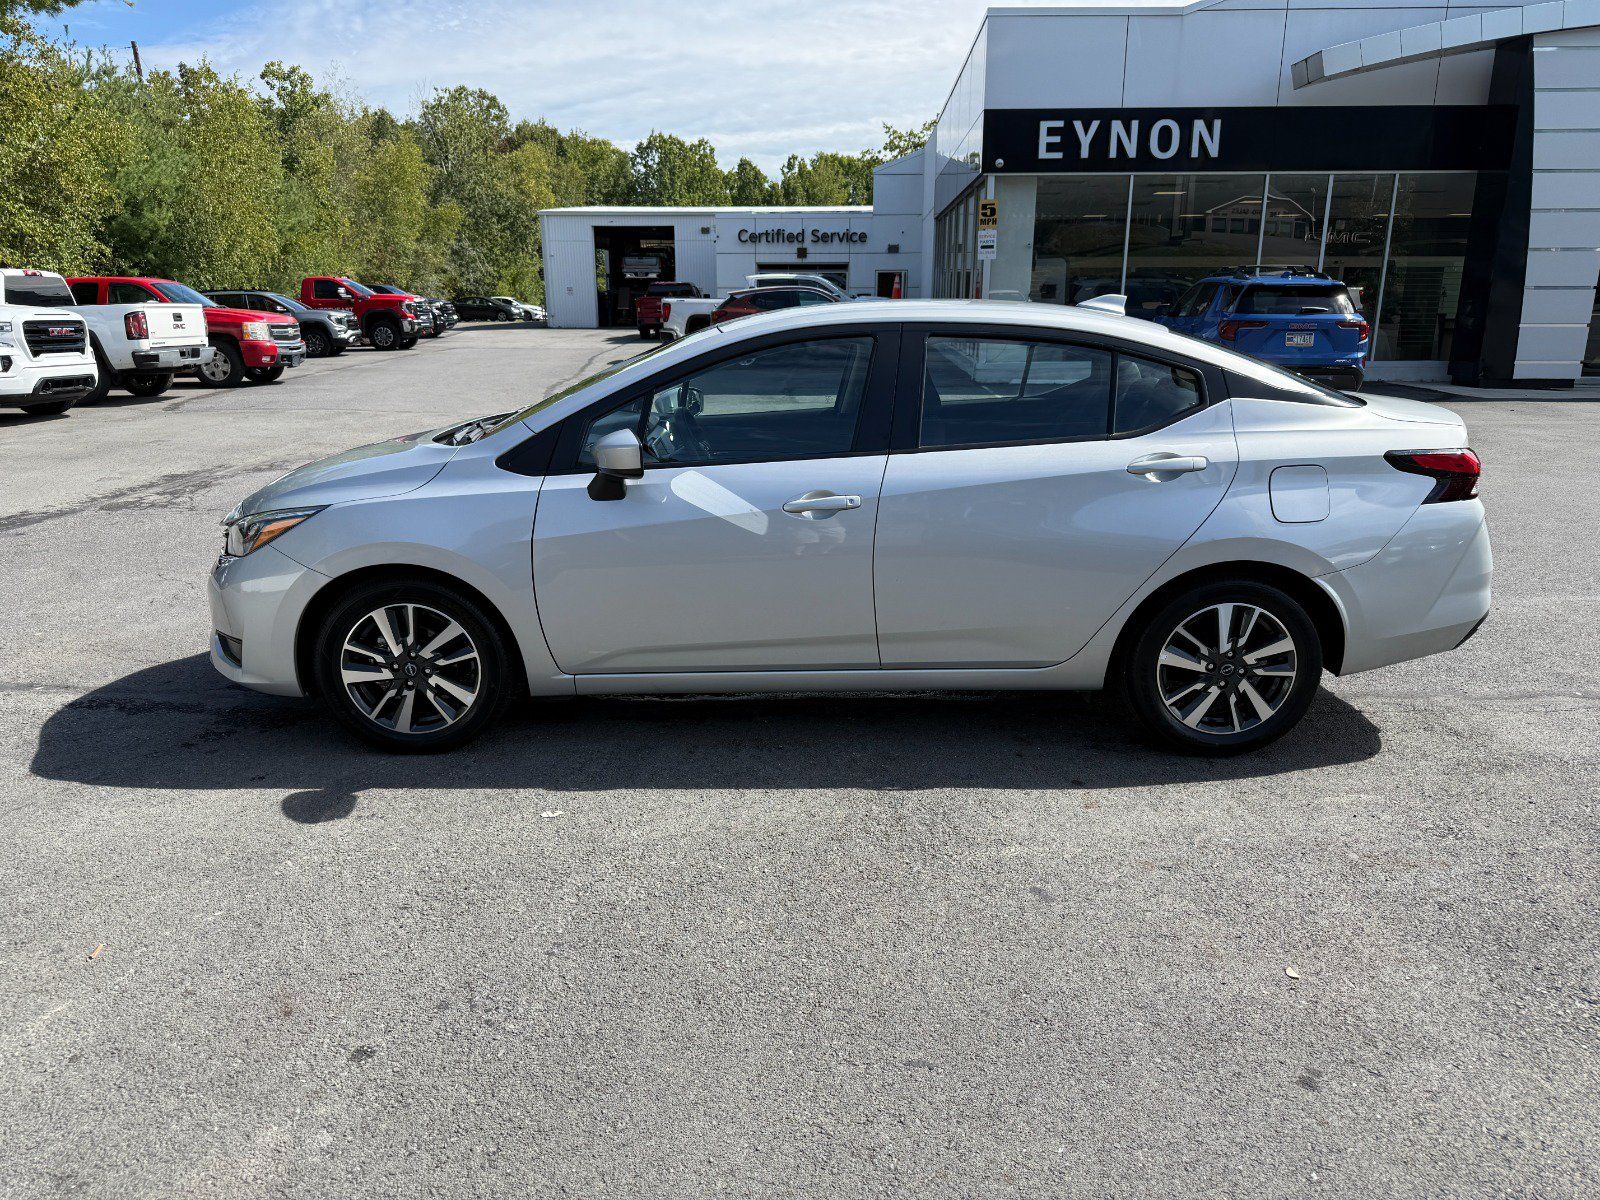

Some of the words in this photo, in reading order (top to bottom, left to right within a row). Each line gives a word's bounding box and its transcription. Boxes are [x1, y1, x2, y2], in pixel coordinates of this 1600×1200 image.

[1038, 118, 1222, 160] EYNON
[981, 203, 996, 217] 5
[737, 228, 805, 243] Certified
[811, 228, 868, 243] Service
[1288, 322, 1318, 330] GMC
